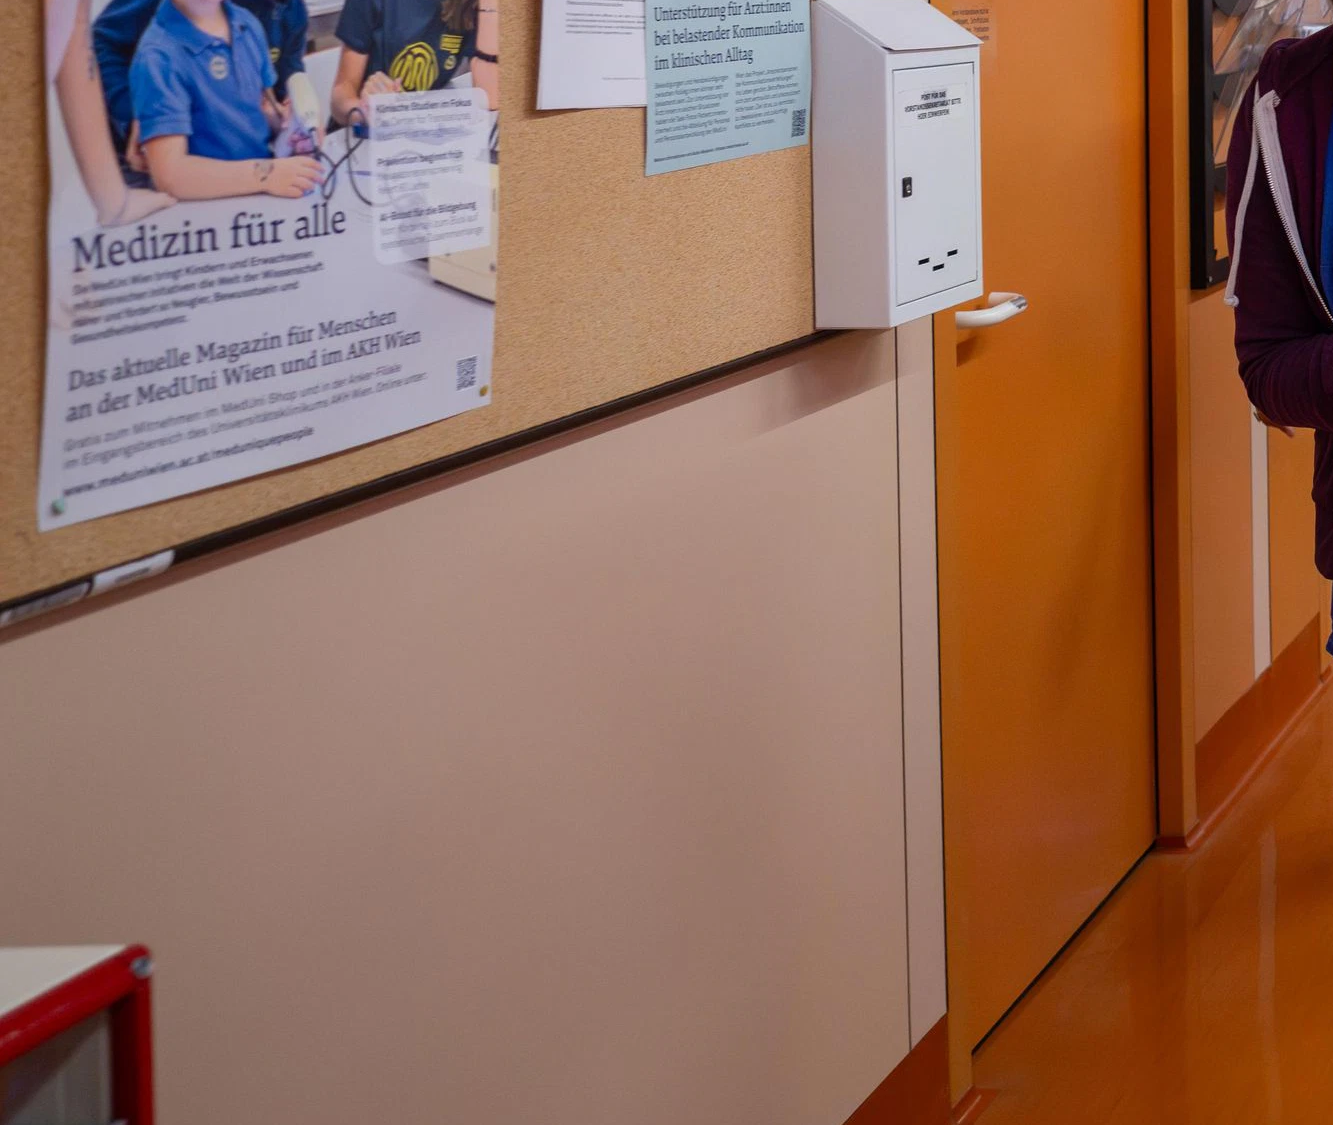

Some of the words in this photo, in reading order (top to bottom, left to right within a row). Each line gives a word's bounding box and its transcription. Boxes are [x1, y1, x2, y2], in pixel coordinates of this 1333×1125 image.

[653, 5, 726, 22] Unterstützung
[727, 1, 742, 16] für
[654, 30, 671, 46] bei
[672, 25, 730, 45] belastender
[732, 20, 805, 39] Kommunikation
[654, 56, 669, 70] im
[671, 49, 723, 68] klinischen
[725, 47, 754, 64] Alltag
[72, 220, 218, 273] Medizin
[229, 212, 285, 249] für
[294, 202, 346, 240] alle
[185, 261, 225, 275] Kindern
[228, 257, 250, 270] und
[243, 271, 260, 282] der
[67, 368, 107, 392] Das
[111, 347, 191, 382] aktuelle
[196, 332, 282, 364] Magazin
[286, 325, 315, 346] für
[318, 310, 397, 340] Menschen
[65, 402, 93, 422] an
[97, 391, 131, 415] der
[135, 370, 218, 406] MedUni
[222, 362, 276, 386] Wien
[282, 350, 317, 375] und
[322, 349, 343, 366] im
[345, 335, 381, 360] AKH
[385, 330, 421, 351] Wien
[268, 390, 297, 405] Shop
[299, 385, 319, 397] und
